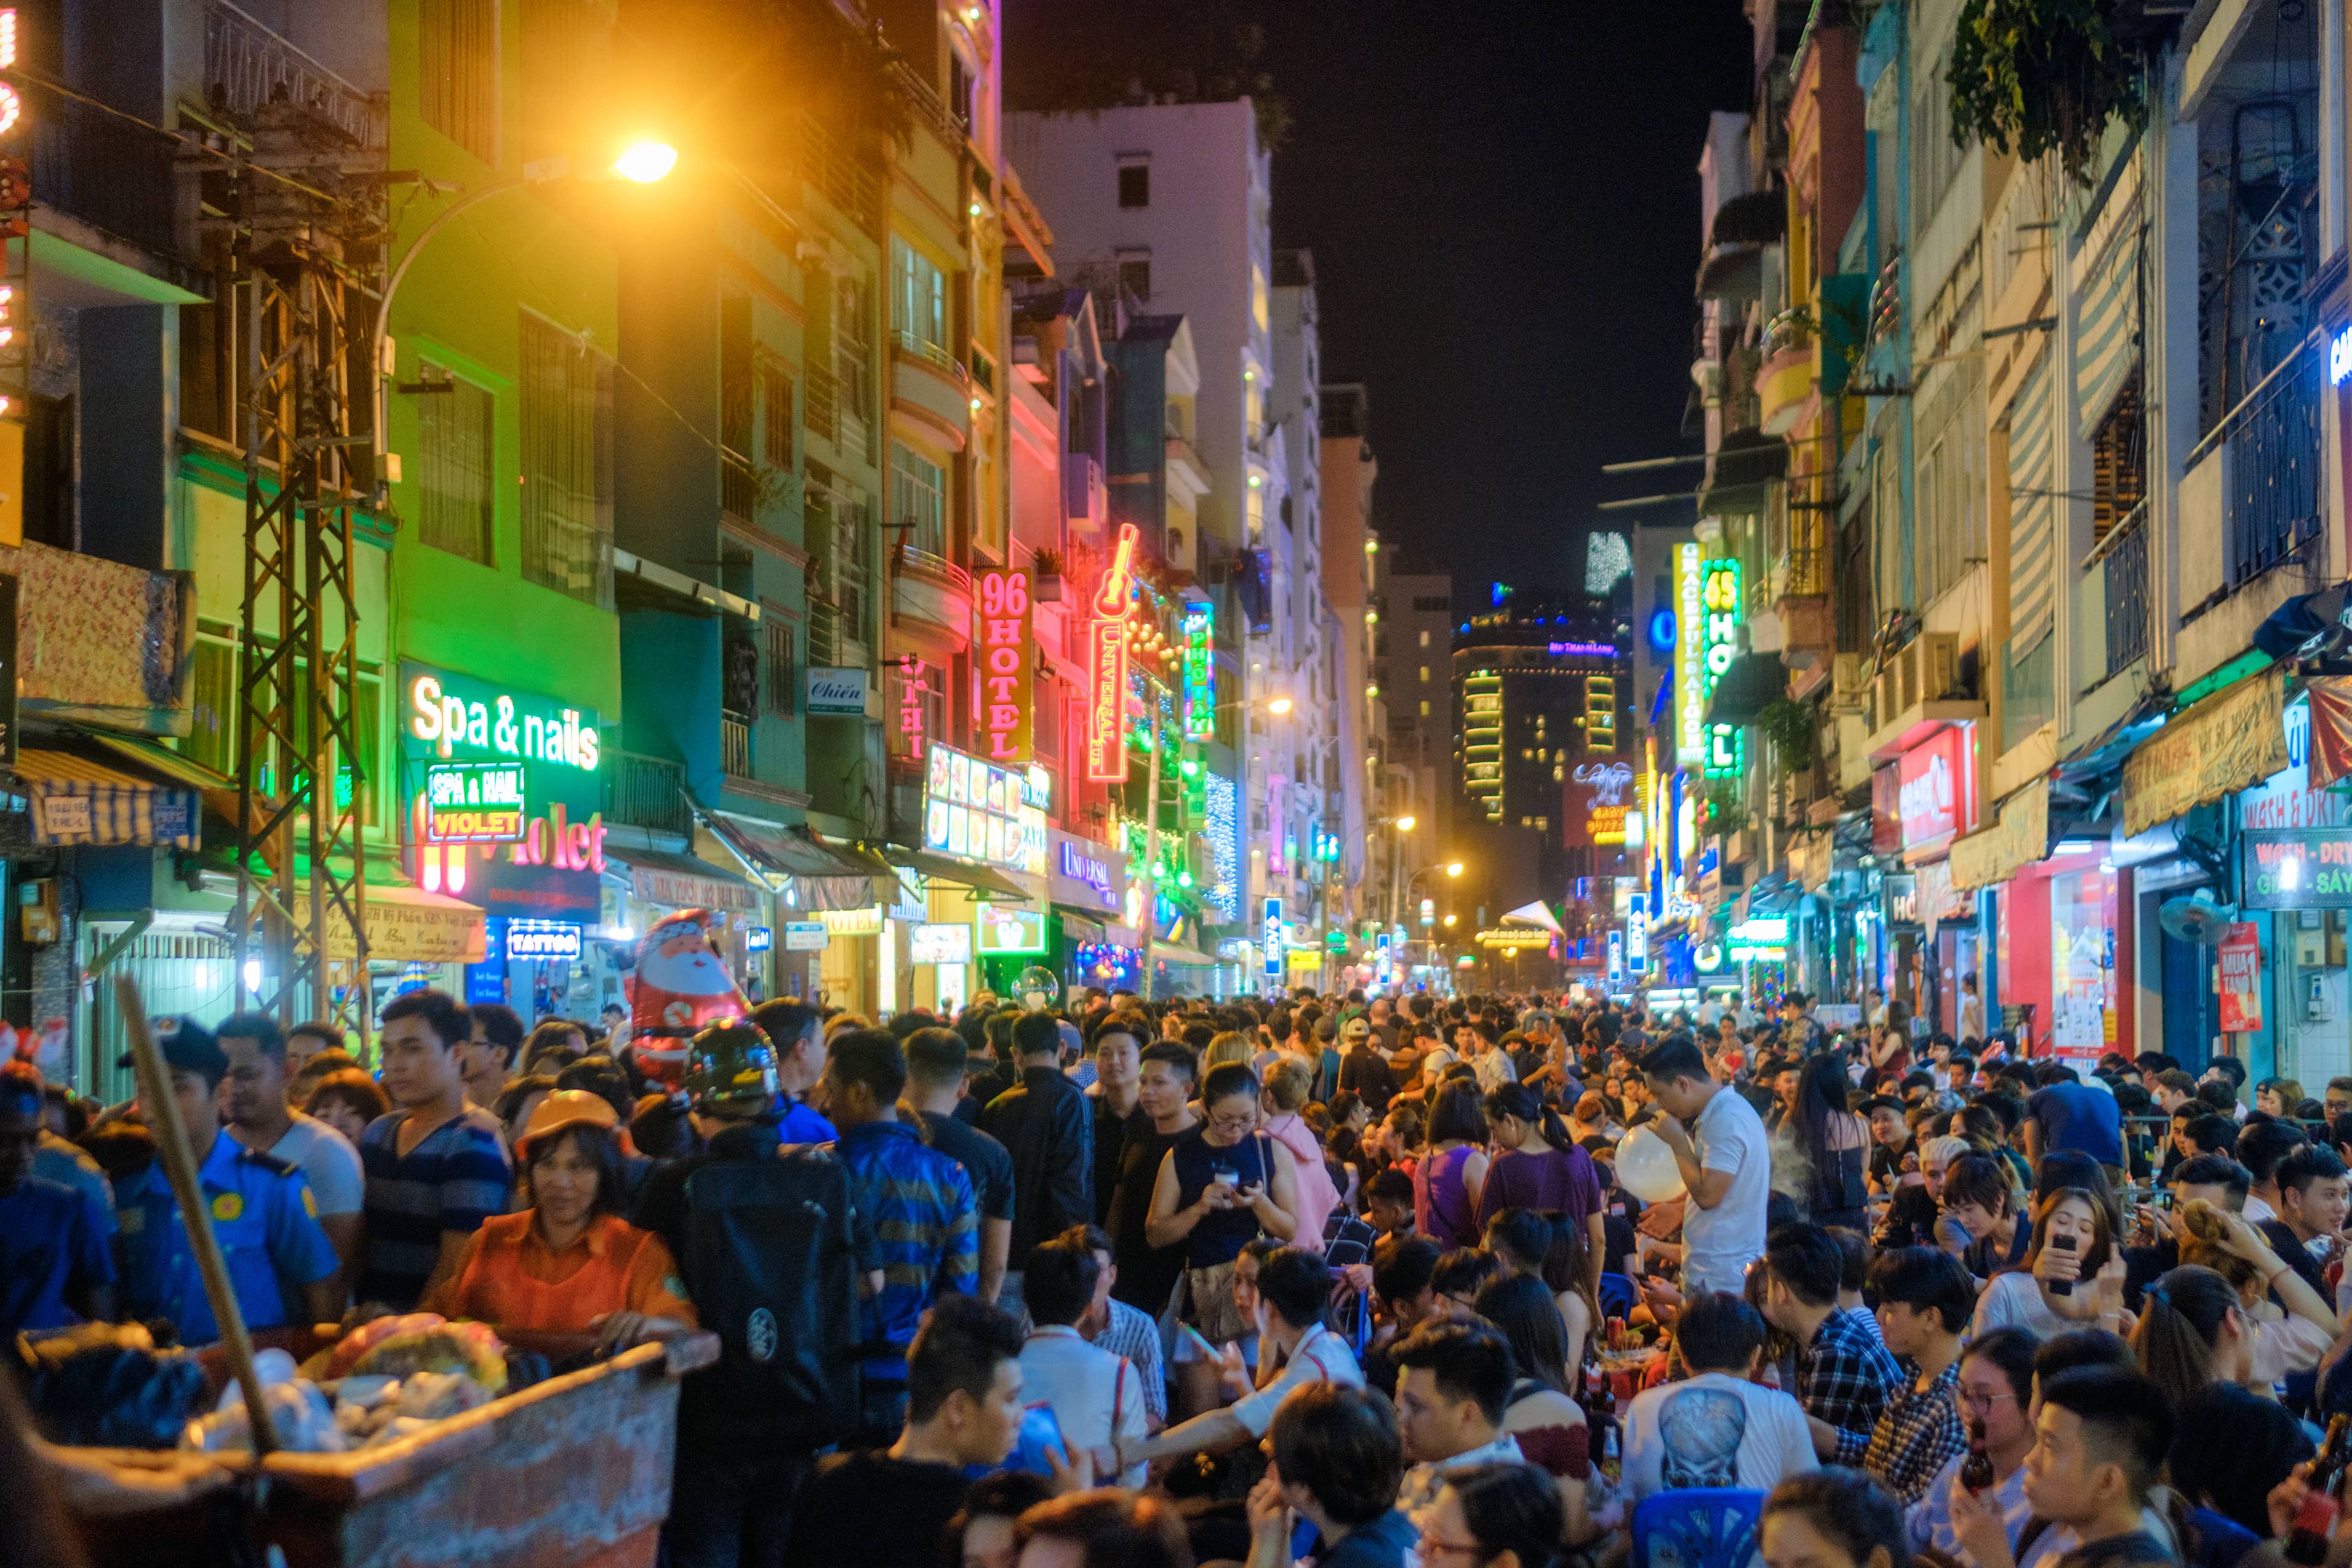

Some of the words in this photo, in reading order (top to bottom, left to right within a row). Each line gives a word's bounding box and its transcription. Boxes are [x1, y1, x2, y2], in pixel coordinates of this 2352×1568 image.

[983, 572, 1027, 615] 96
[1705, 571, 1736, 610] 65
[812, 682, 861, 699] Chiến
[987, 619, 1022, 760] HOTEL
[1098, 625, 1121, 743] UNIVERSAL
[1708, 613, 1734, 766] HOL
[1684, 662, 1700, 748] SAIGON
[415, 677, 488, 758] Spa
[495, 696, 519, 756] &
[525, 709, 599, 771] nails
[1092, 738, 1101, 766] PUB
[432, 772, 464, 805] SPA
[468, 778, 480, 804] &
[482, 771, 521, 805] NAIL
[433, 811, 521, 835] VIOLET
[1586, 820, 1626, 833] BUFFA
[2245, 794, 2285, 829] WASH
[2291, 790, 2300, 827] &
[1065, 841, 1109, 888] UNIVERSAL
[2256, 843, 2306, 864] WASH
[385, 927, 406, 945] By
[512, 933, 577, 952] TATTOO
[1267, 929, 1279, 961] BIDV
